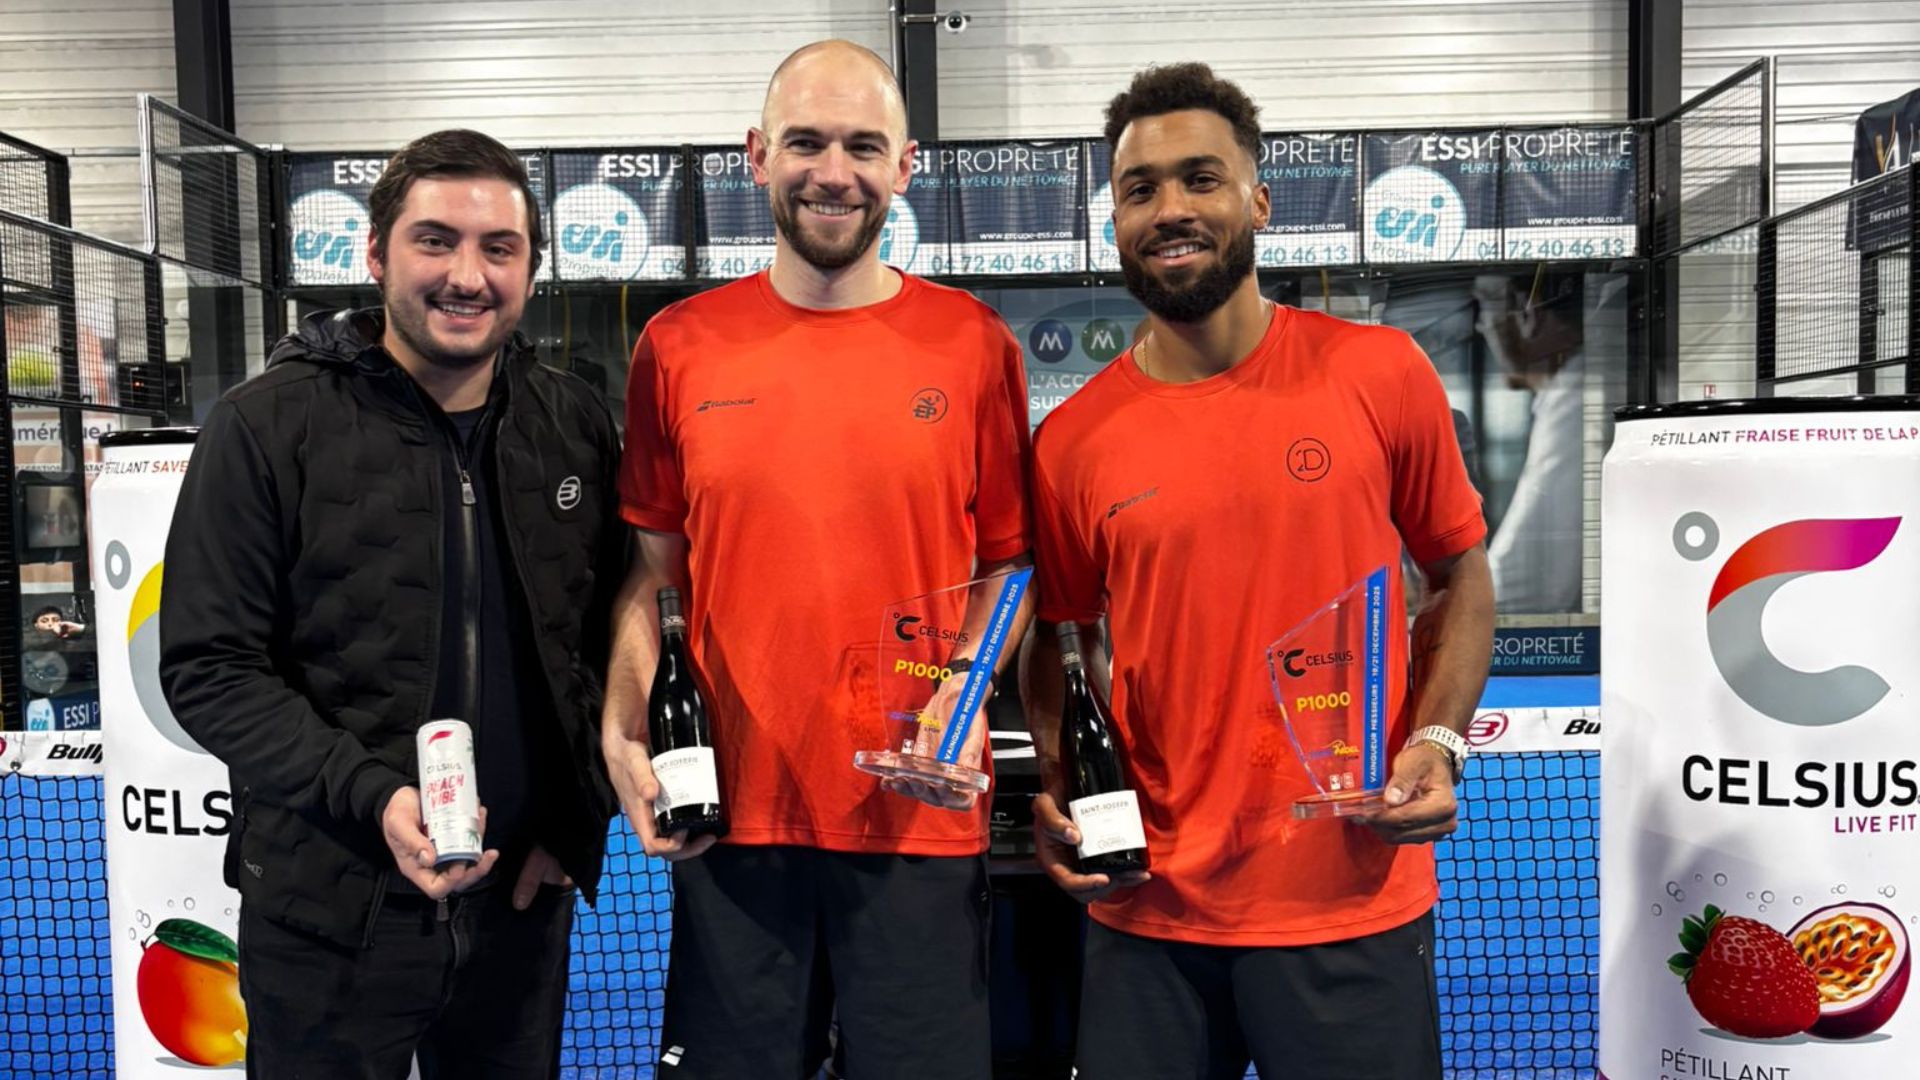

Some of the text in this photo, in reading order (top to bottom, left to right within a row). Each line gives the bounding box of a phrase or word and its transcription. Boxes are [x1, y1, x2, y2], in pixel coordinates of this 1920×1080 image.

[1422, 136, 1480, 161] ESSI
[604, 154, 660, 177] ESSI
[1261, 245, 1347, 263] 40 46 13
[1508, 241, 1532, 257] 72
[1539, 240, 1563, 257] 40
[1569, 239, 1594, 257] 46
[1602, 238, 1624, 257] 13
[720, 257, 746, 274] 40
[961, 256, 985, 272] 72
[990, 255, 1015, 272] 40
[1021, 254, 1045, 271] 46
[1050, 254, 1075, 272] 13
[1651, 430, 1731, 446] PÉTILLANT
[1735, 428, 1800, 443] FRAISE
[1805, 428, 1857, 442] FRUIT
[1864, 428, 1886, 441] DE
[1888, 427, 1909, 441] LA
[919, 625, 969, 643] CELSIUS
[1491, 633, 1585, 656] ROPRETÉ
[1305, 651, 1354, 667] CELSIUS
[1504, 655, 1519, 665] DU
[1521, 655, 1582, 666] NETTOYAGE
[895, 659, 952, 682] P1000
[1296, 691, 1351, 713] P1000
[64, 703, 89, 729] ESSI
[1682, 755, 1917, 808] CELSIUS
[1835, 814, 1917, 833] LIVE FIT
[1660, 1048, 1790, 1080] PÉTILLANT
